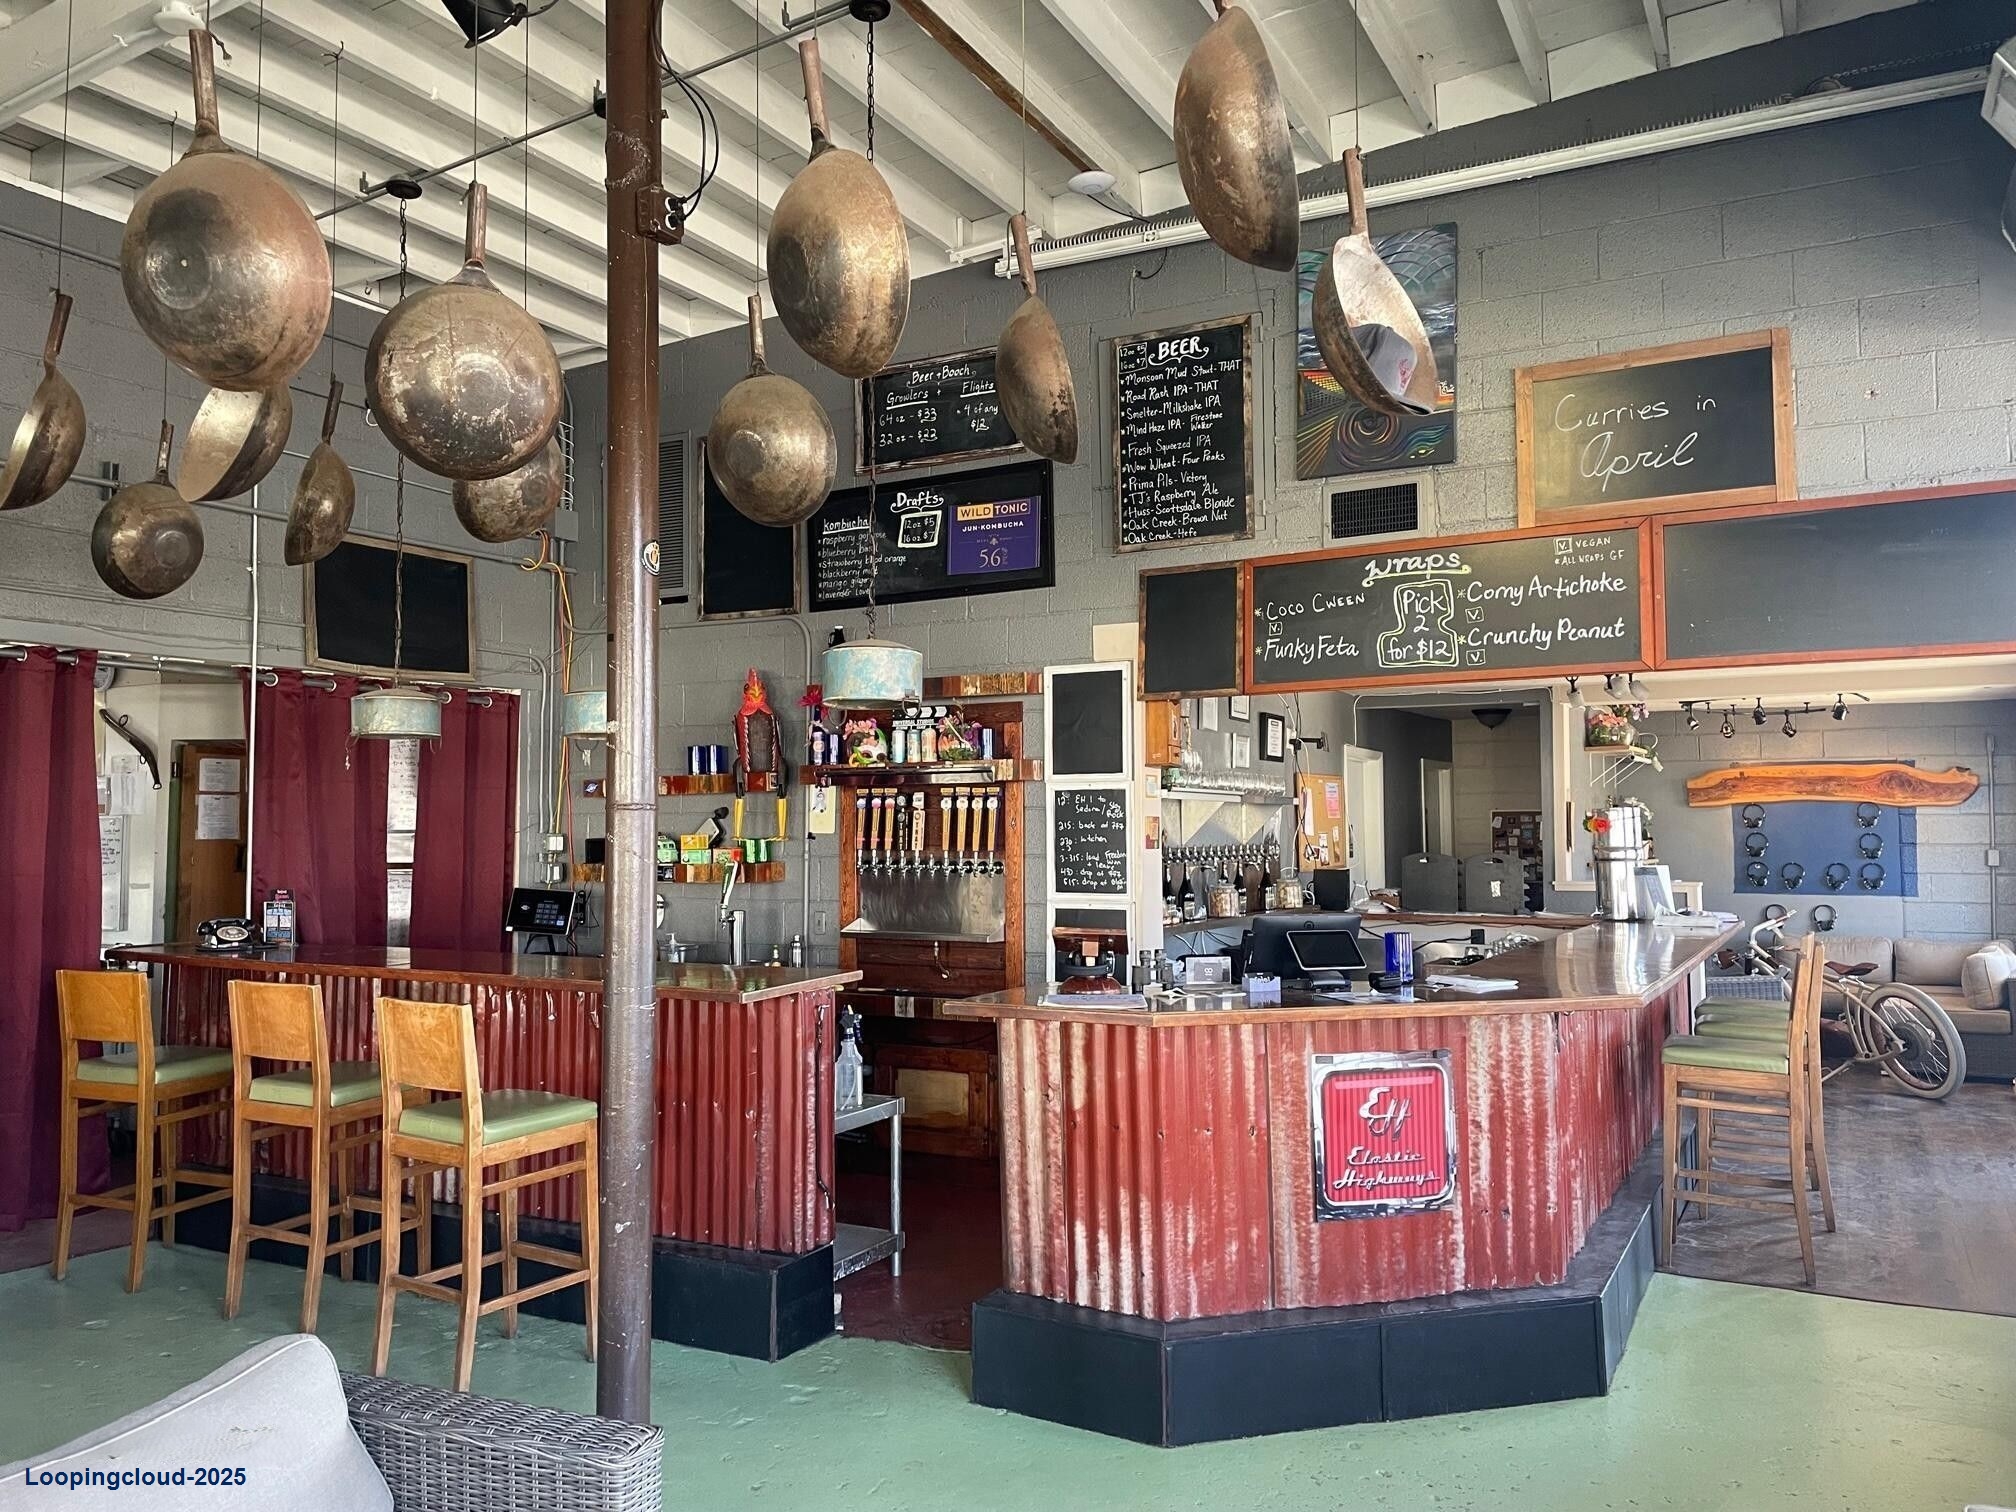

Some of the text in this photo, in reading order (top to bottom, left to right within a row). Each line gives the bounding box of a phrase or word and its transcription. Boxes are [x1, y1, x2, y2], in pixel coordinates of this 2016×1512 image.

[1158, 336, 1203, 361] BEER
[912, 371, 934, 385] Beer
[942, 364, 970, 380] Booch
[1125, 372, 1164, 386] Monsoon
[1165, 367, 1187, 380] Mud
[962, 380, 994, 393] Flights
[1125, 388, 1146, 404] Road
[1149, 386, 1169, 401] Rash
[886, 389, 929, 406] Growlers
[1205, 394, 1222, 408] IPA
[880, 413, 893, 427] 64
[896, 415, 906, 423] oz
[917, 407, 938, 420] $33
[963, 402, 999, 416] 4 of any
[1555, 394, 1717, 432] Curries in
[970, 418, 987, 431] $12
[1126, 422, 1147, 437] Mind
[1149, 421, 1166, 433] Haze
[879, 433, 893, 447] 32
[917, 428, 938, 440] $22
[1128, 434, 1211, 458] Fresh Squeezed IPA
[1202, 449, 1226, 462] Peaks
[1580, 430, 1700, 493] April
[1128, 476, 1154, 491] Prima
[1180, 471, 1208, 486] Victory
[896, 490, 940, 508] Drafts
[1128, 482, 1220, 505] TJ's Raspberry Ale
[1203, 495, 1236, 510] Blonde
[960, 502, 1028, 518] WILD TONIC
[904, 520, 912, 529] 12
[924, 518, 935, 527] $5
[1128, 519, 1149, 531] Oak
[1210, 510, 1228, 522] Nut
[822, 534, 856, 548] raspberry
[903, 534, 911, 543] 16
[923, 531, 935, 542] $7
[1127, 531, 1147, 544] Oak
[1575, 536, 1611, 548] VEGAN
[822, 545, 856, 559] blueberry
[884, 555, 907, 567] orange
[1561, 549, 1625, 566] ALL WRAPS GF
[822, 566, 860, 579] blackberry
[822, 579, 848, 591] mango
[1466, 571, 1628, 607] Corny Artichoke
[1402, 589, 1447, 615] Pick
[1413, 614, 1430, 634] 2
[1468, 616, 1626, 651] Crunchy Peanut
[1264, 635, 1360, 665] Funky Feta
[1387, 636, 1452, 661] for $12
[1347, 1145, 1426, 1166] Elastic
[1333, 1169, 1441, 1190] Highways
